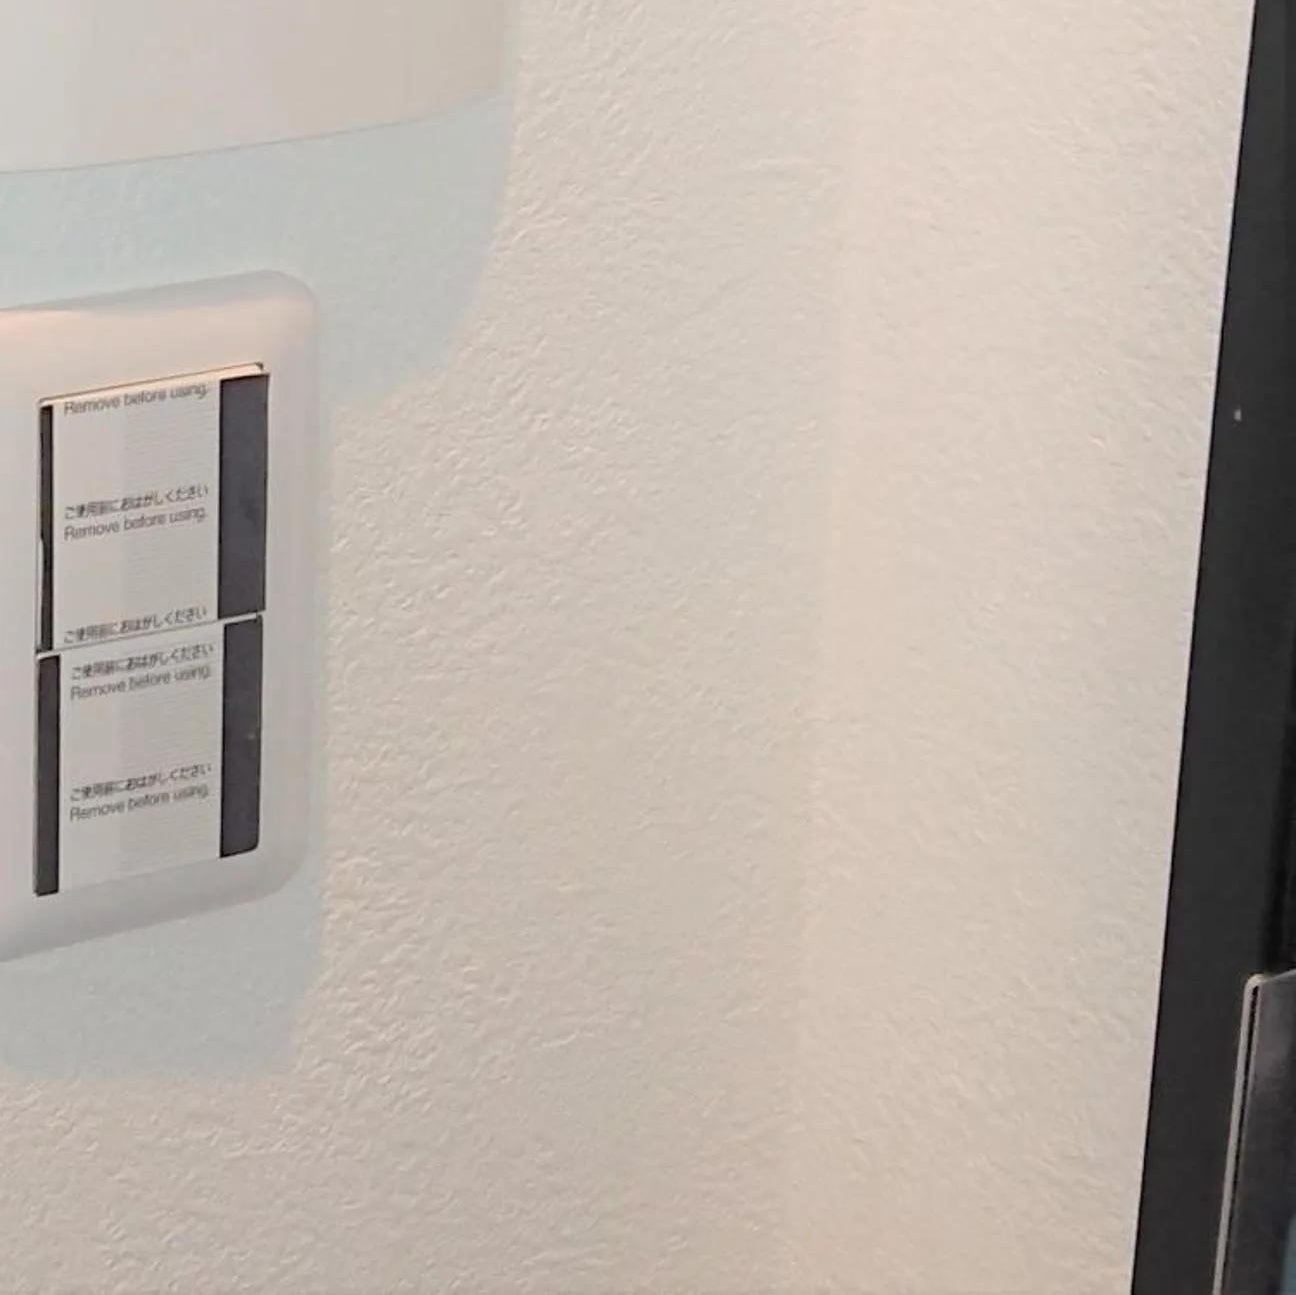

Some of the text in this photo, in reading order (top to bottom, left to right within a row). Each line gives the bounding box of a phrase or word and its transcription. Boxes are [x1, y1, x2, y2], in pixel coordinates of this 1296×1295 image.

[64, 396, 120, 416] Remove
[124, 388, 167, 406] before
[64, 521, 120, 541] Remove
[124, 513, 166, 531] before
[70, 681, 126, 700] Remove
[128, 673, 171, 690] before
[69, 803, 125, 822] Remove
[127, 793, 171, 810] before
